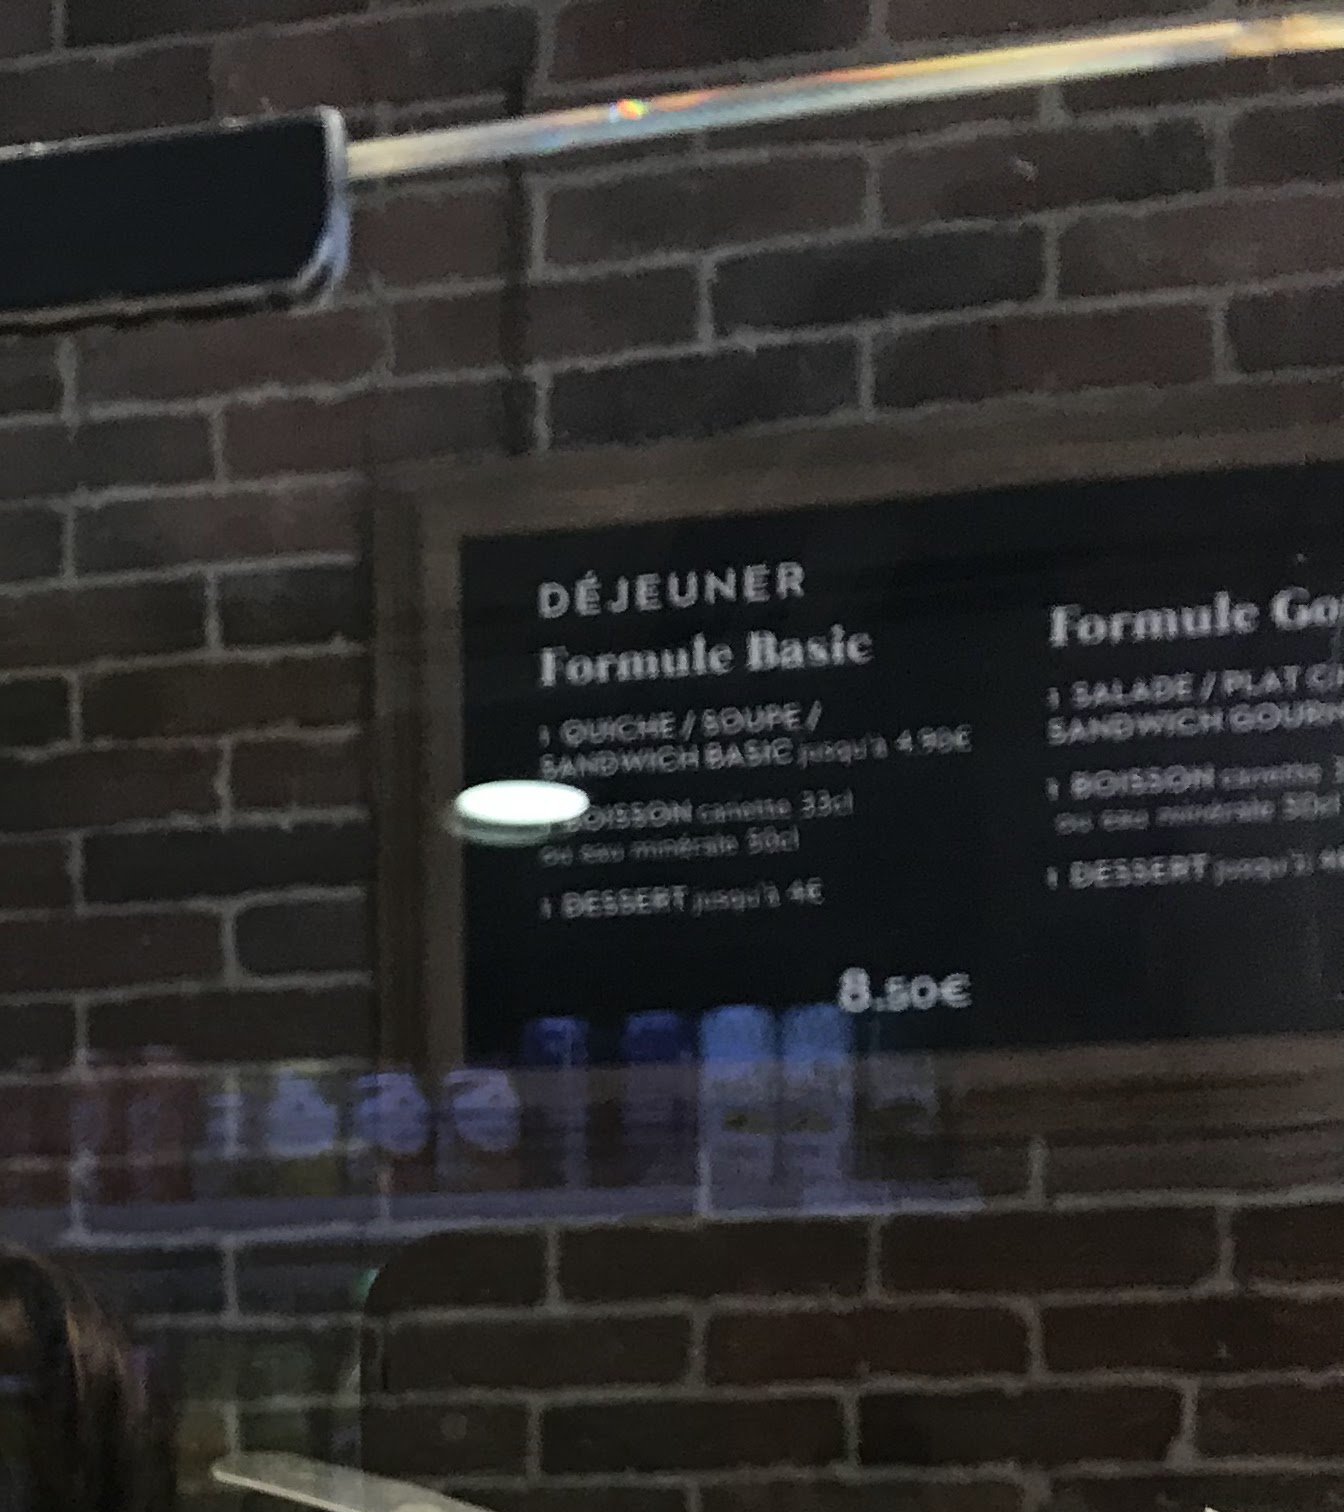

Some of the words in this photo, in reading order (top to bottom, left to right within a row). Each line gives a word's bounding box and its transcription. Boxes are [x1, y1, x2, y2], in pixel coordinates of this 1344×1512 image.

[537, 561, 806, 619] DÉJEUNER
[1048, 590, 1260, 649] Formule
[1269, 586, 1344, 632] Go
[538, 631, 735, 688] Formule
[745, 623, 875, 672] Basic
[1070, 671, 1194, 709] SALADE
[1219, 664, 1301, 698] PLAT
[558, 711, 676, 748] QUICHE
[701, 702, 802, 737] SOUPE
[1046, 706, 1224, 747] SANDWICH
[538, 746, 700, 780] SANDWICH
[704, 737, 795, 771] BASIC
[1069, 764, 1215, 799] BOISSON
[1069, 852, 1211, 891] DESSERT
[560, 883, 689, 919] DESSERT
[836, 966, 973, 1014] 8.50€
